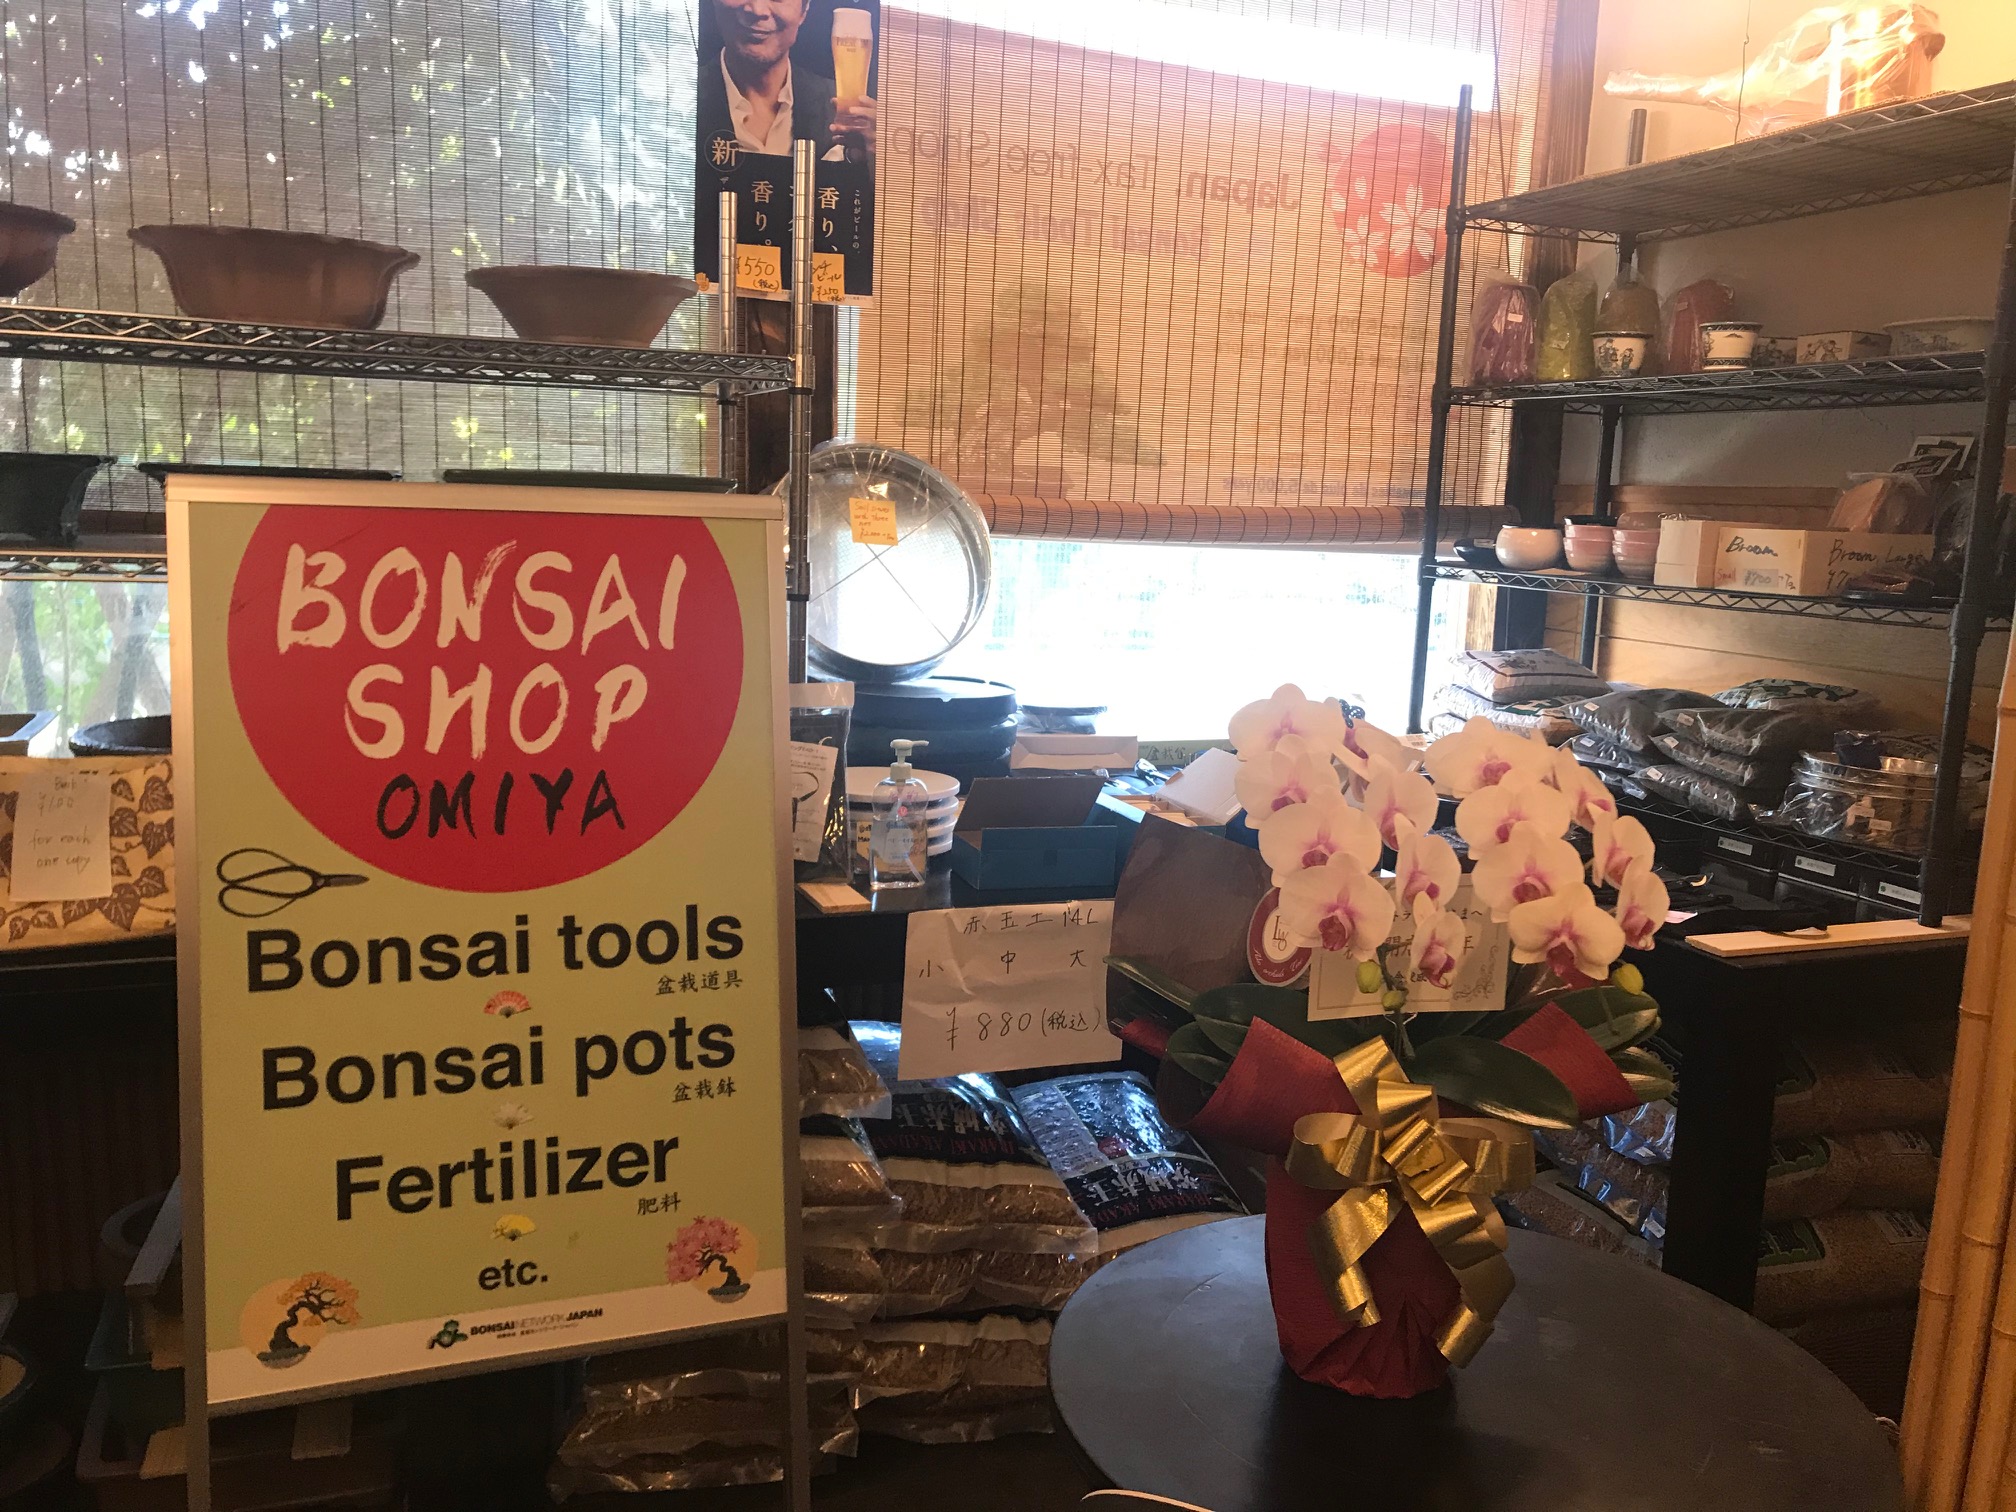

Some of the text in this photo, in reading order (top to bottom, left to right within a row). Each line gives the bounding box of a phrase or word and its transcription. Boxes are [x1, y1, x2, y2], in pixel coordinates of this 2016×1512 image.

[711, 136, 739, 167] 新
[1724, 535, 1779, 558] Broom
[1827, 538, 1875, 567] Broom
[277, 540, 687, 655] BONSAI
[344, 663, 648, 760] SHOP
[376, 767, 627, 840] OMIYA
[246, 904, 744, 993] Bonsai tools
[918, 949, 1087, 978] 小 中 大
[655, 970, 744, 996] 盆栽道具
[261, 1015, 736, 1111] Bonsai pots
[671, 1078, 736, 1103] 盆栽鉢
[335, 1136, 679, 1221] Fertilizer
[636, 1193, 682, 1217] 肥料
[477, 1257, 549, 1292] etc.
